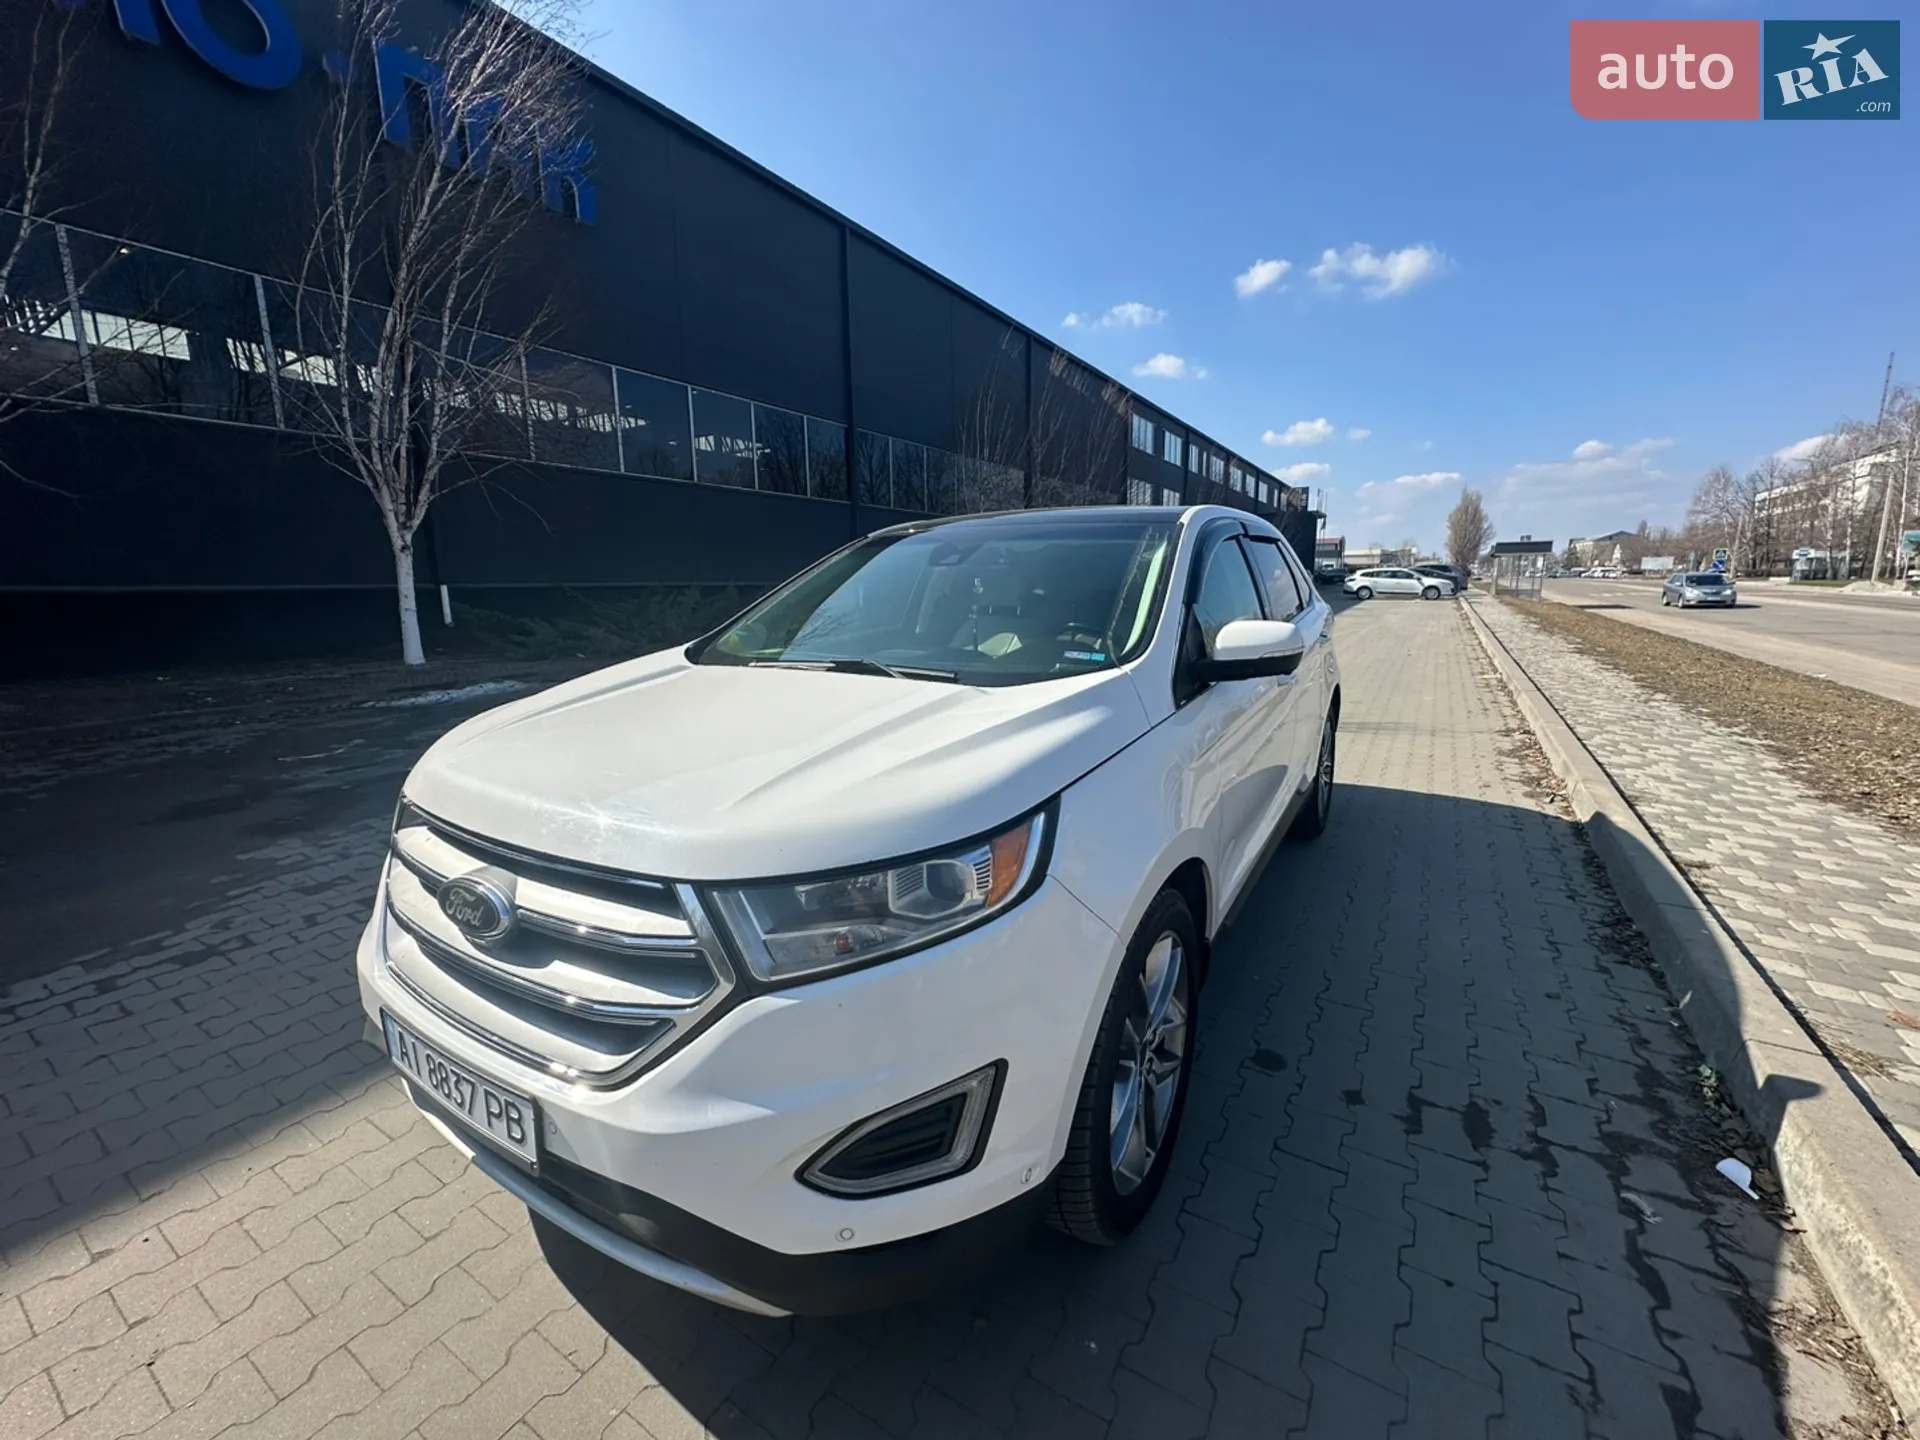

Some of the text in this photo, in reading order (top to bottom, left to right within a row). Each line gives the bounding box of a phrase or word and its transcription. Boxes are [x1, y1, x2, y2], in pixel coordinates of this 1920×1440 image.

[445, 887, 485, 927] Ford
[398, 1030, 422, 1078] AI
[425, 1052, 476, 1116] 8837
